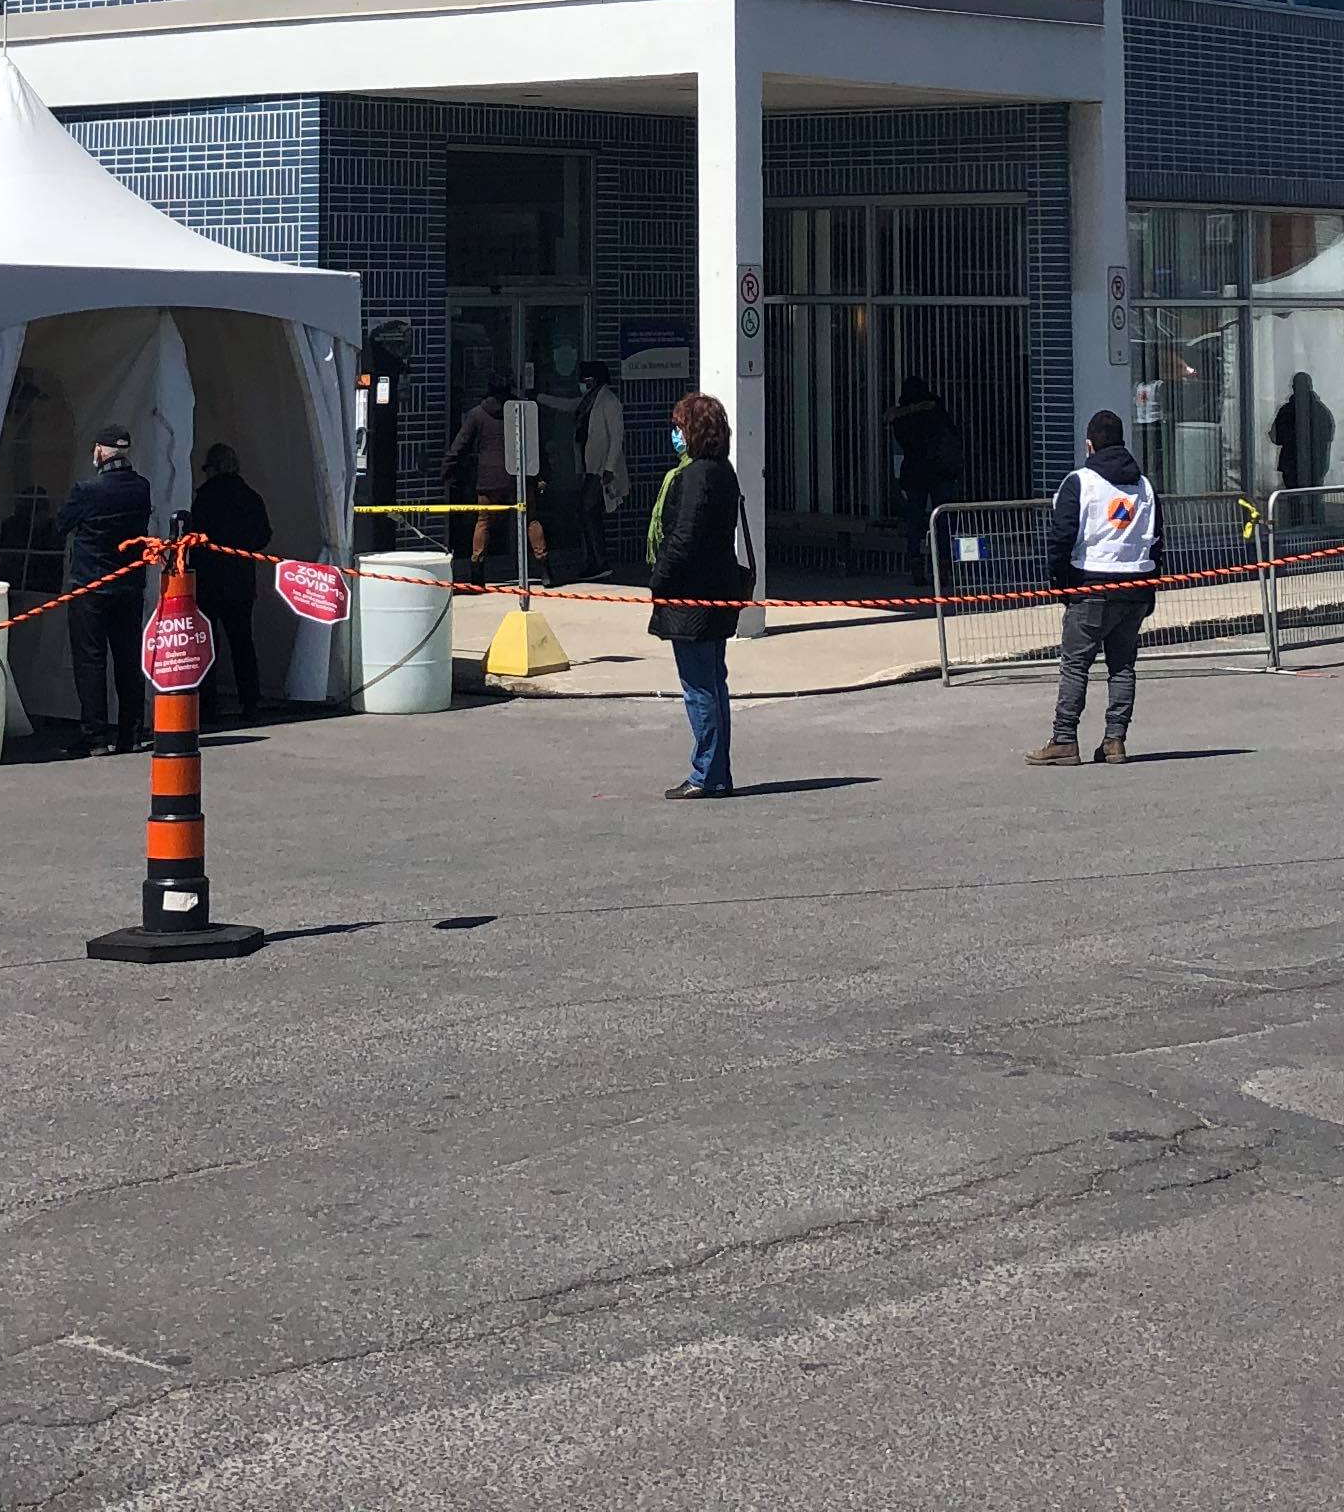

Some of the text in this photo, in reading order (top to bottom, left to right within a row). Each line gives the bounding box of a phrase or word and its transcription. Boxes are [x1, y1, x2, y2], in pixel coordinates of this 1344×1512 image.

[297, 565, 336, 584] ZONE
[284, 571, 345, 601] COVID-19
[147, 632, 207, 651] COVID-19
